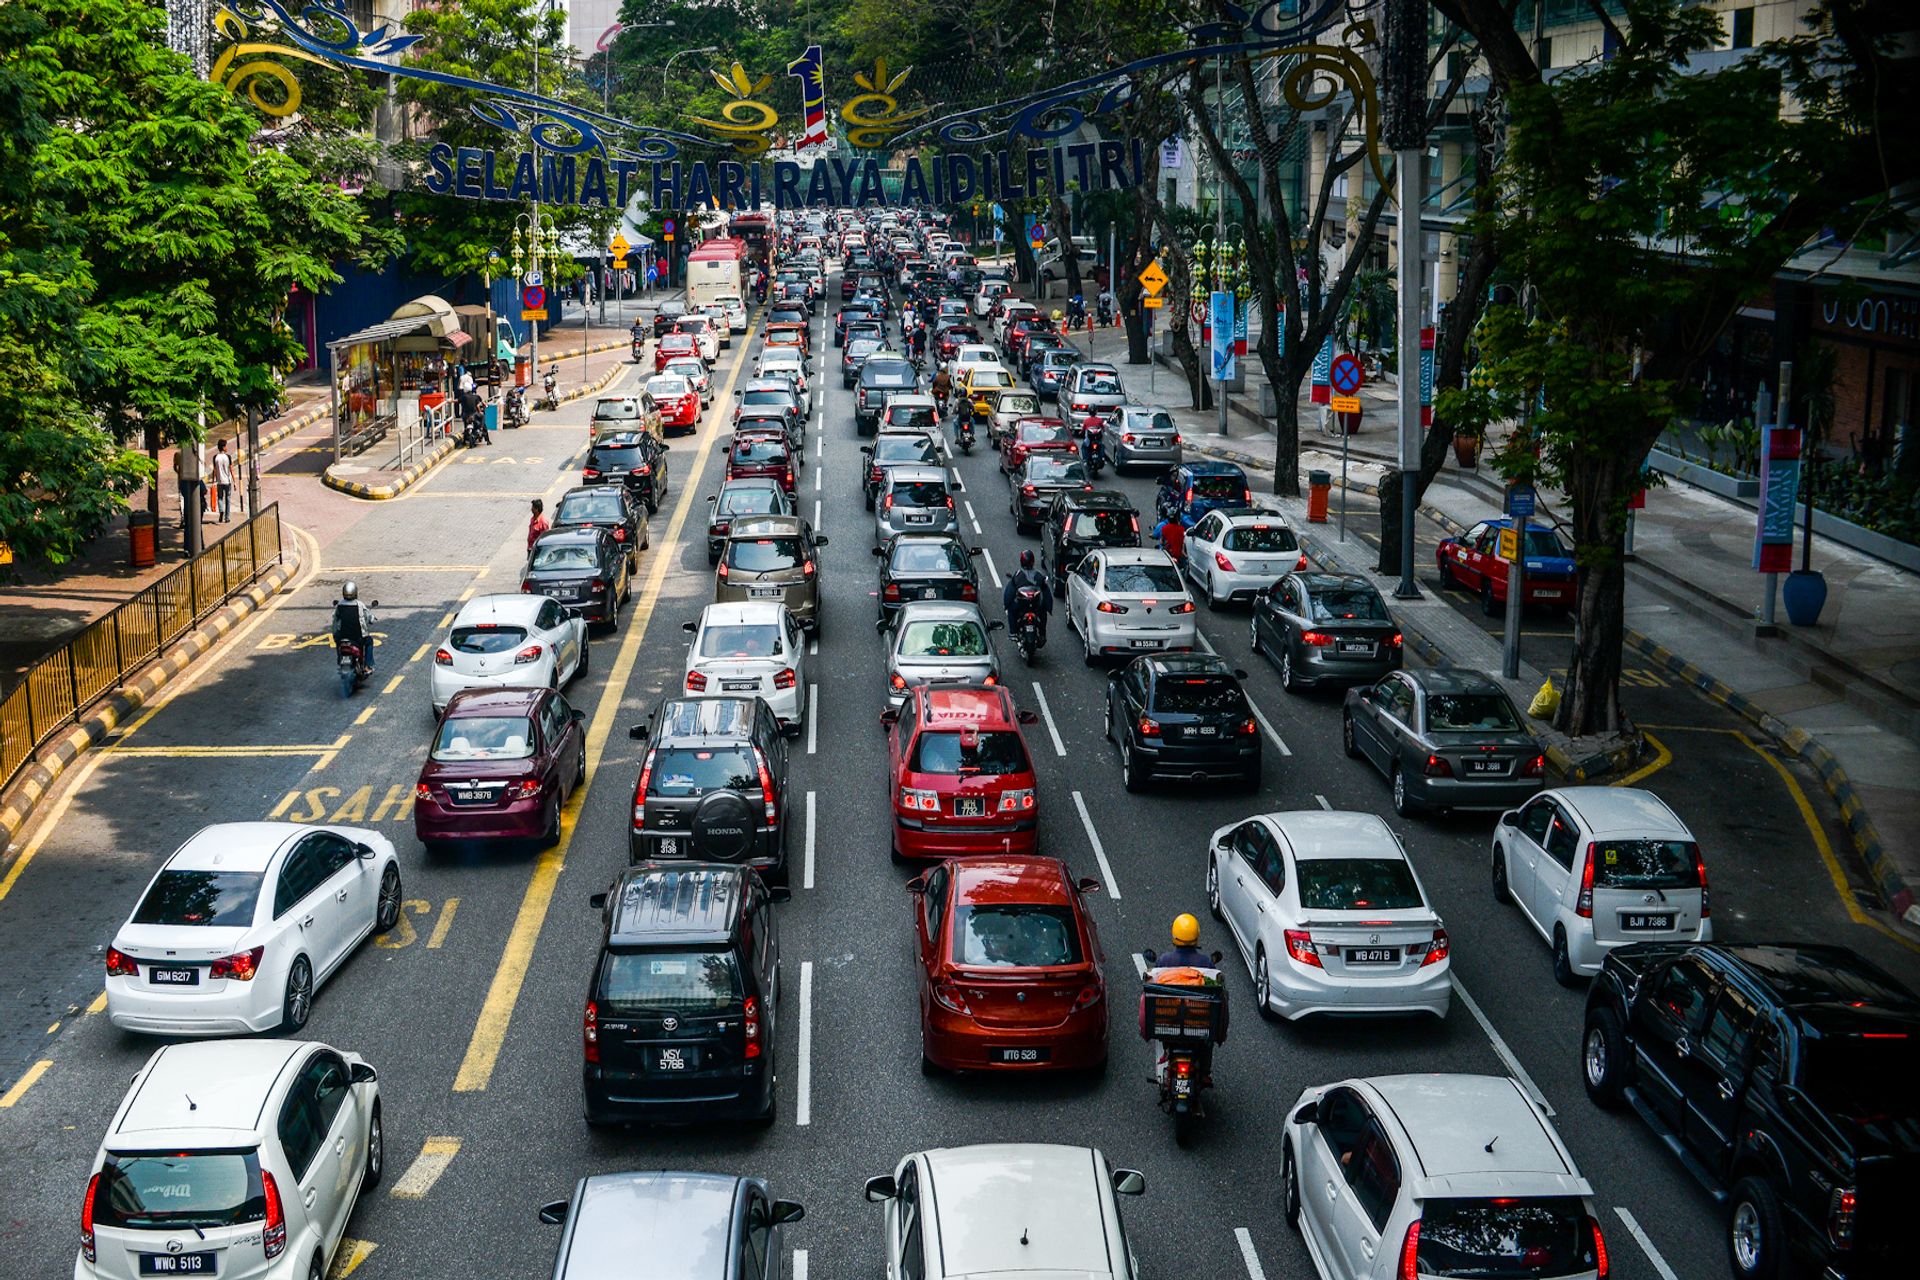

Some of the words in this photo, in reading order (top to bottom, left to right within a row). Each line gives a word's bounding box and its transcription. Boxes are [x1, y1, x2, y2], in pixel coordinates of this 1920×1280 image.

[427, 142, 638, 208] SELAMAT
[652, 160, 761, 210] HARI
[774, 157, 887, 209] RAYA
[900, 138, 1145, 207] AIDILFITRI
[1763, 469, 1783, 537] BAZAR
[1777, 469, 1793, 537] RAMADAN
[290, 784, 416, 823] SAH
[1368, 950, 1383, 961] 471
[171, 970, 191, 982] 6217
[662, 1048, 681, 1060] WSY
[1003, 1049, 1019, 1060] WTG
[1020, 1049, 1037, 1060] 528
[154, 1256, 176, 1271] WWQ
[180, 1256, 202, 1271] 5113
